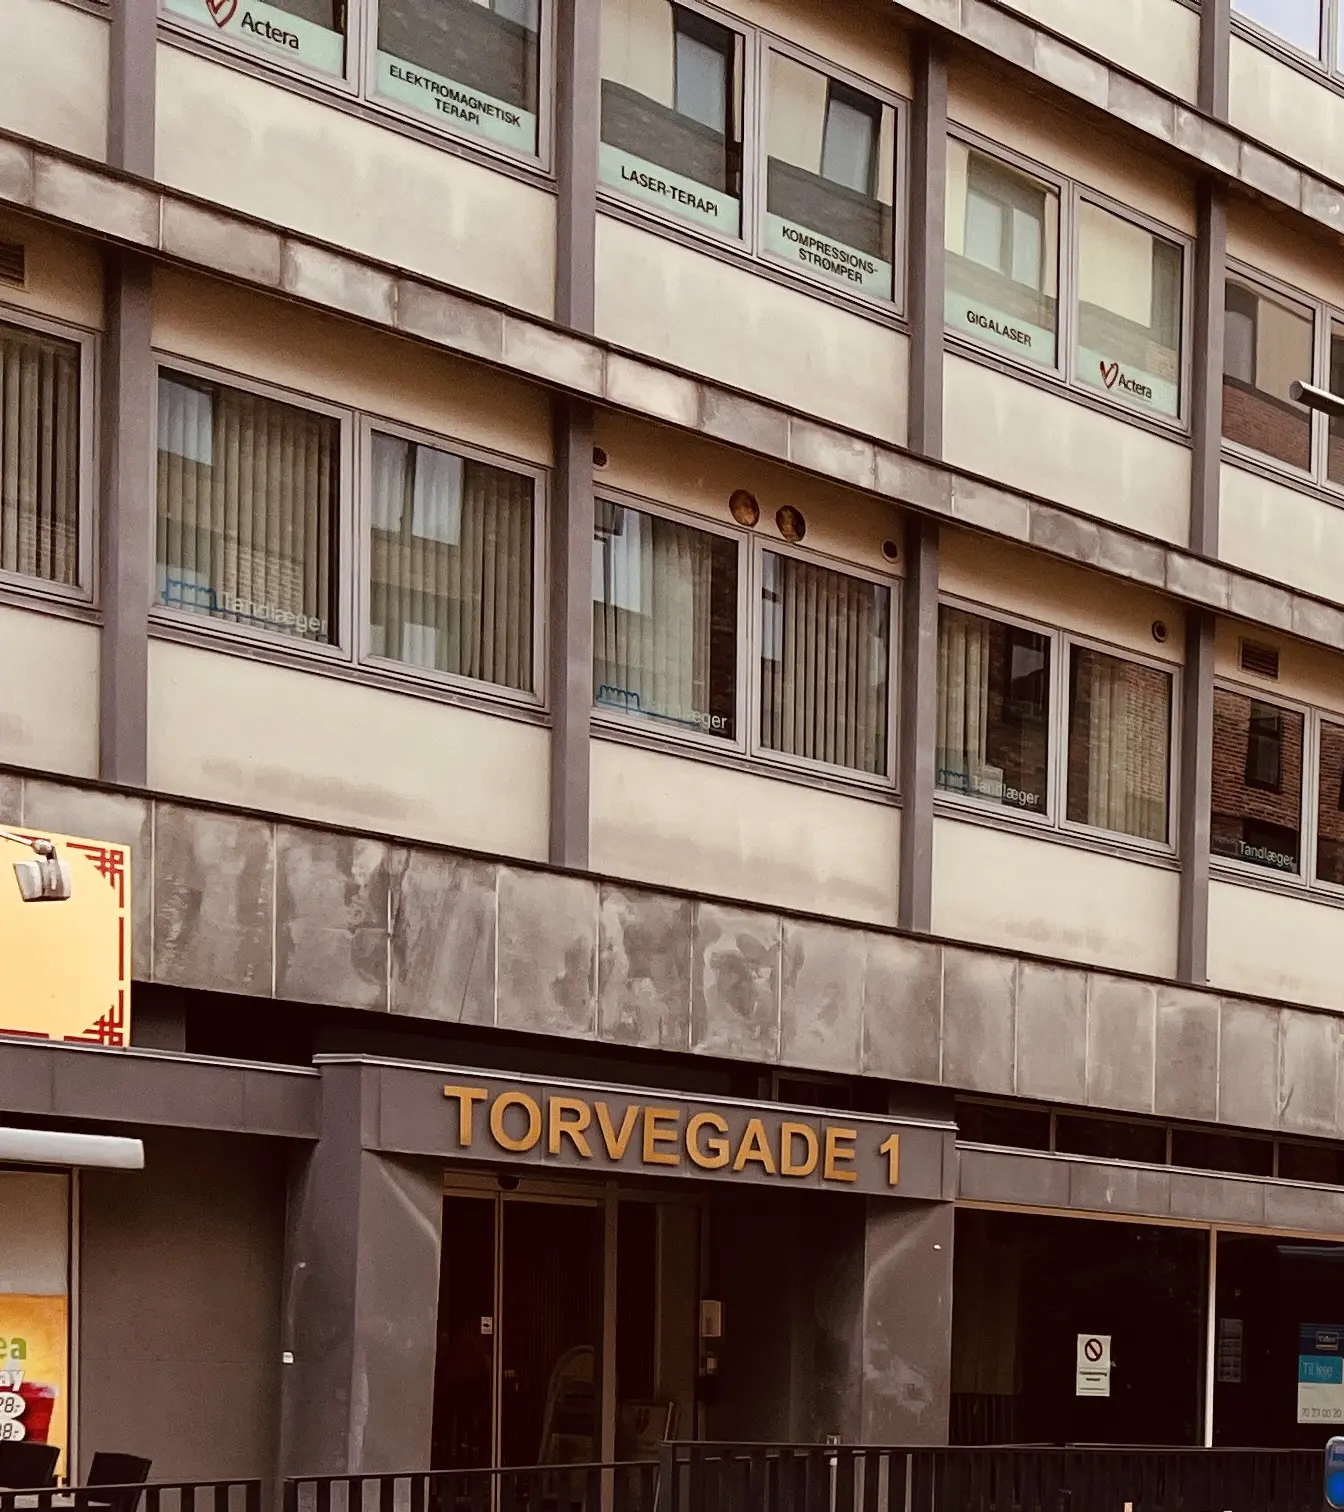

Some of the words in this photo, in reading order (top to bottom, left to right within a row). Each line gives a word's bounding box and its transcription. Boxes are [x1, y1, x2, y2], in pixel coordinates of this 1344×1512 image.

[241, 11, 299, 50] Actera
[389, 64, 521, 128] ELEKTROMAGNETISK
[434, 97, 480, 125] TERAPI
[620, 165, 718, 217] LASER-TERAPI
[781, 225, 879, 275] KOMPRESSIONS-
[966, 310, 1032, 348] GIGALASER
[1118, 373, 1153, 400] Actera
[443, 1084, 858, 1183] TORVEGADE
[878, 1133, 901, 1186] 1
